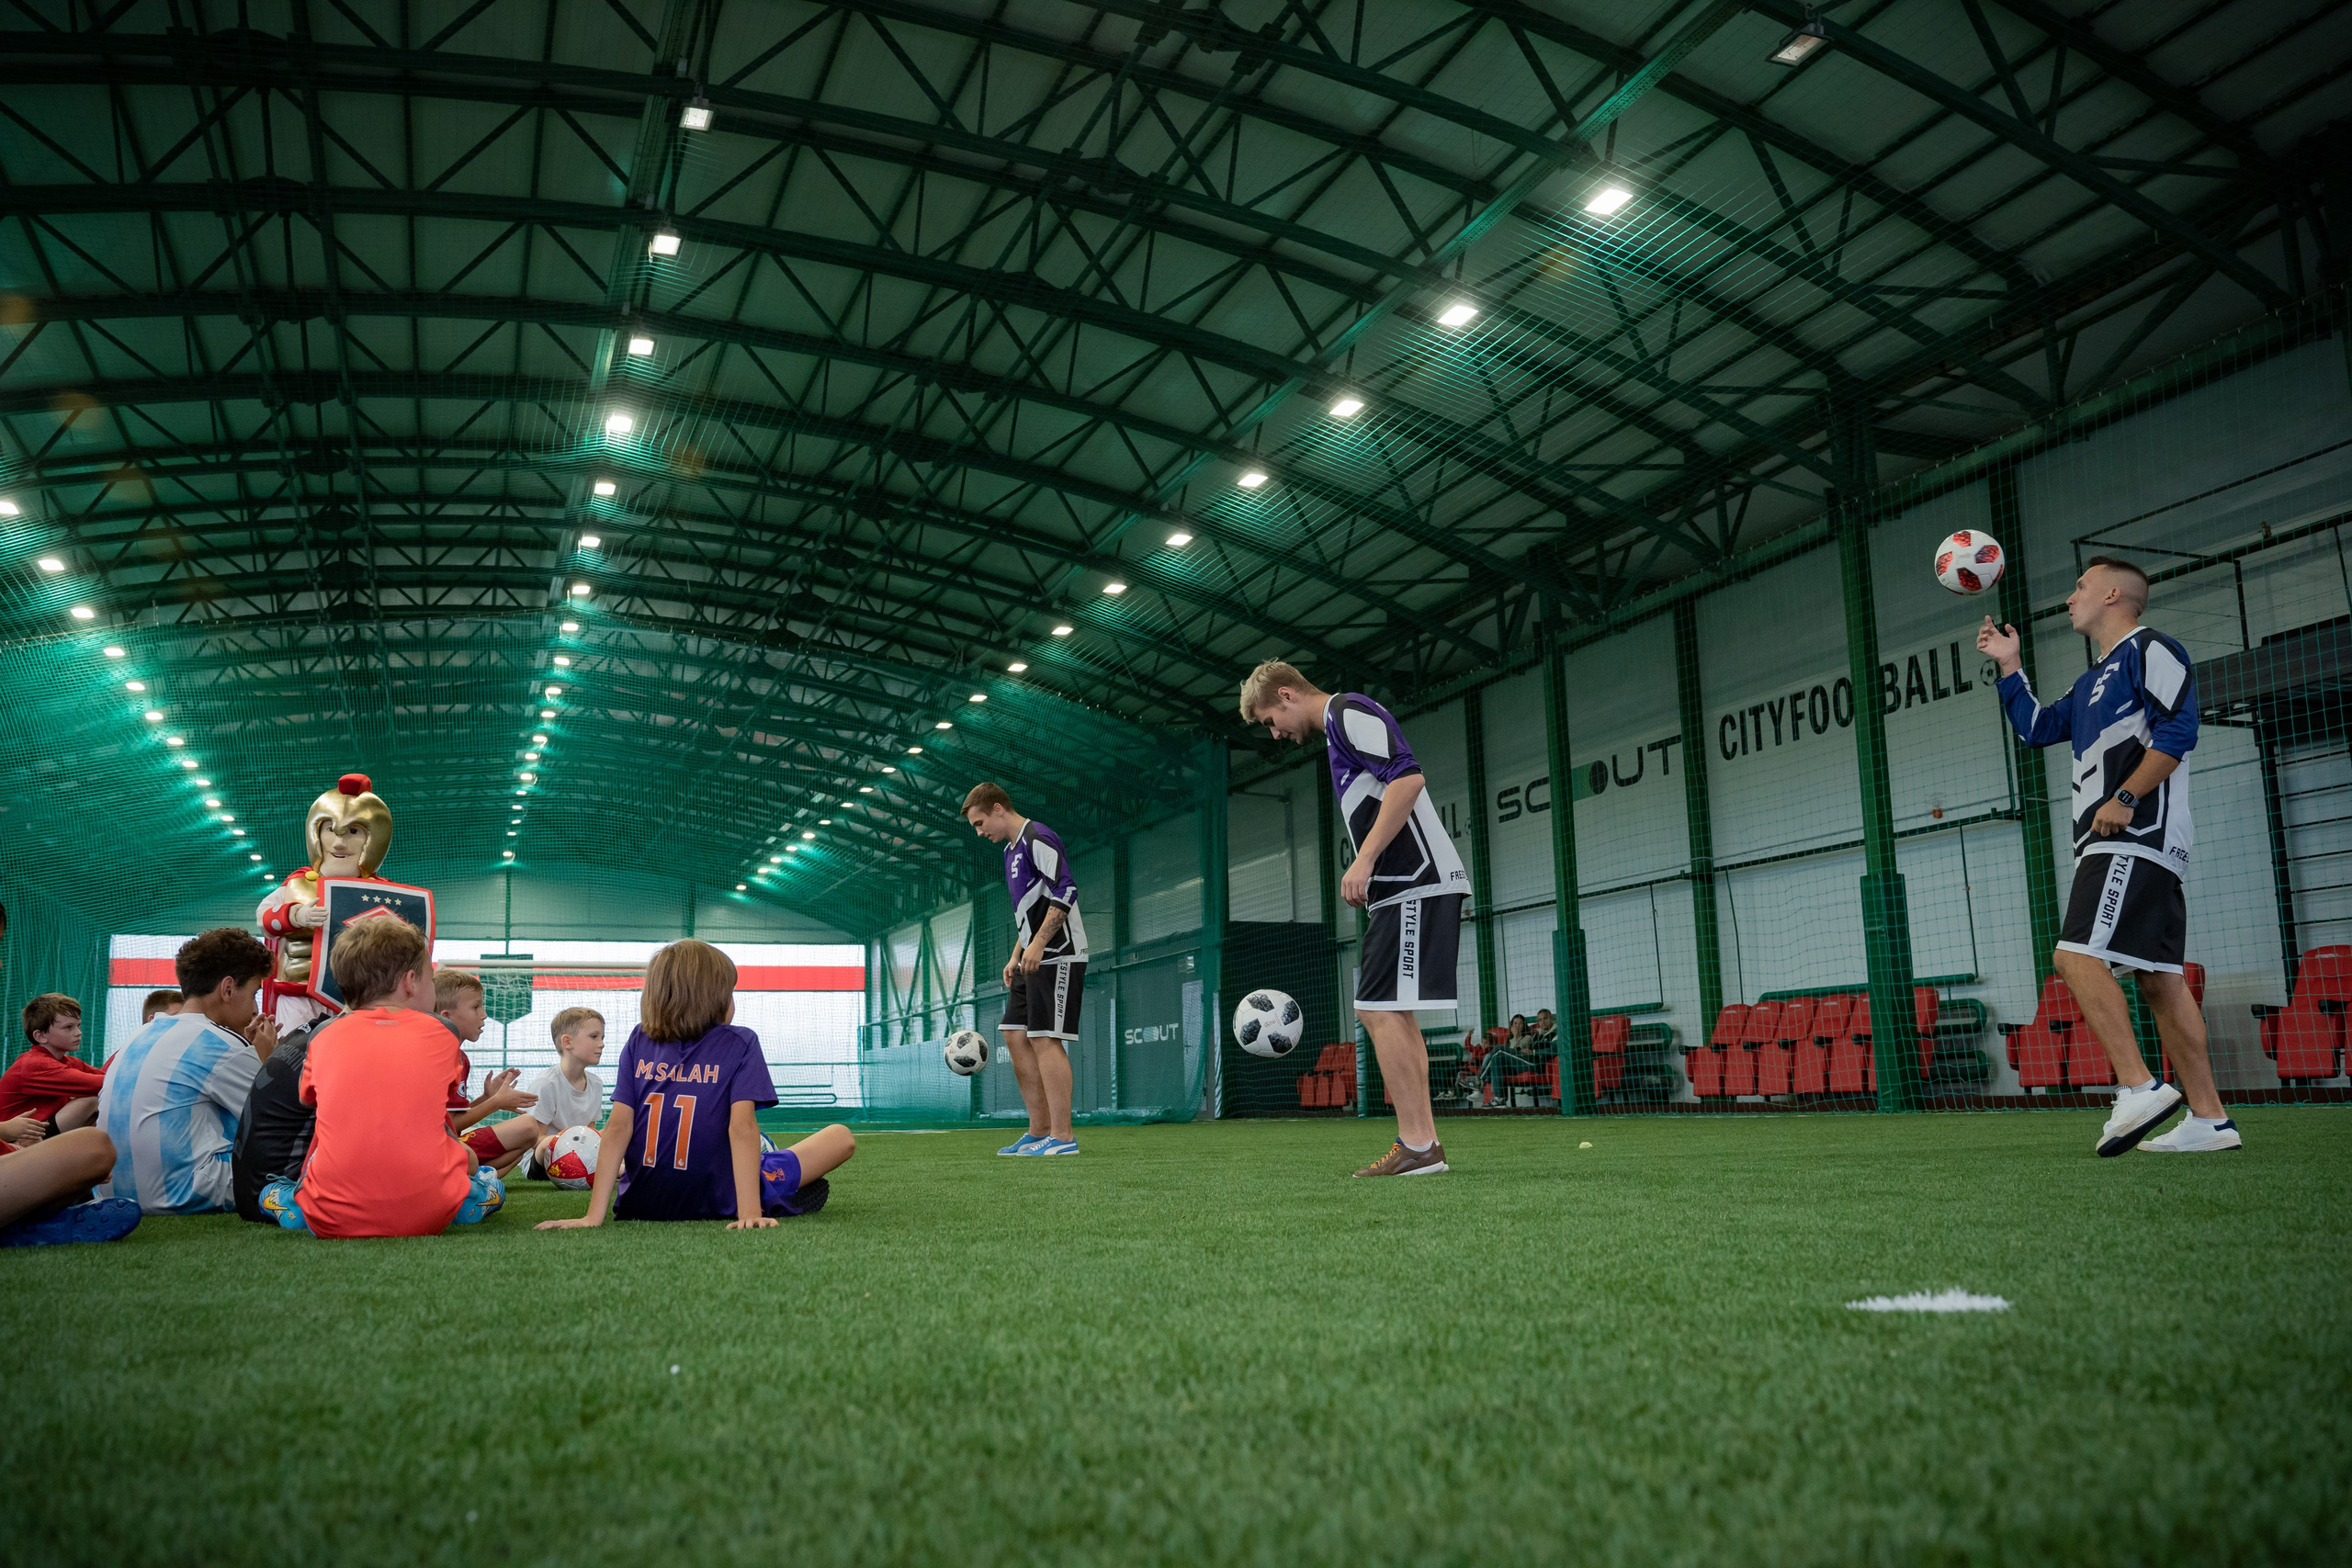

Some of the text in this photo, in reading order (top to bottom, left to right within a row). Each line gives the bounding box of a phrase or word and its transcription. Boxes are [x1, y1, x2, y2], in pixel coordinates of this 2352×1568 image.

[1718, 640, 1973, 761] CITYFOOBALL
[2099, 888, 2120, 929] SPORT
[1402, 941, 1415, 979] SPORT
[1125, 1022, 1179, 1045] SCOUT
[635, 1058, 720, 1084] M.SALAH
[642, 1091, 697, 1171] 11
